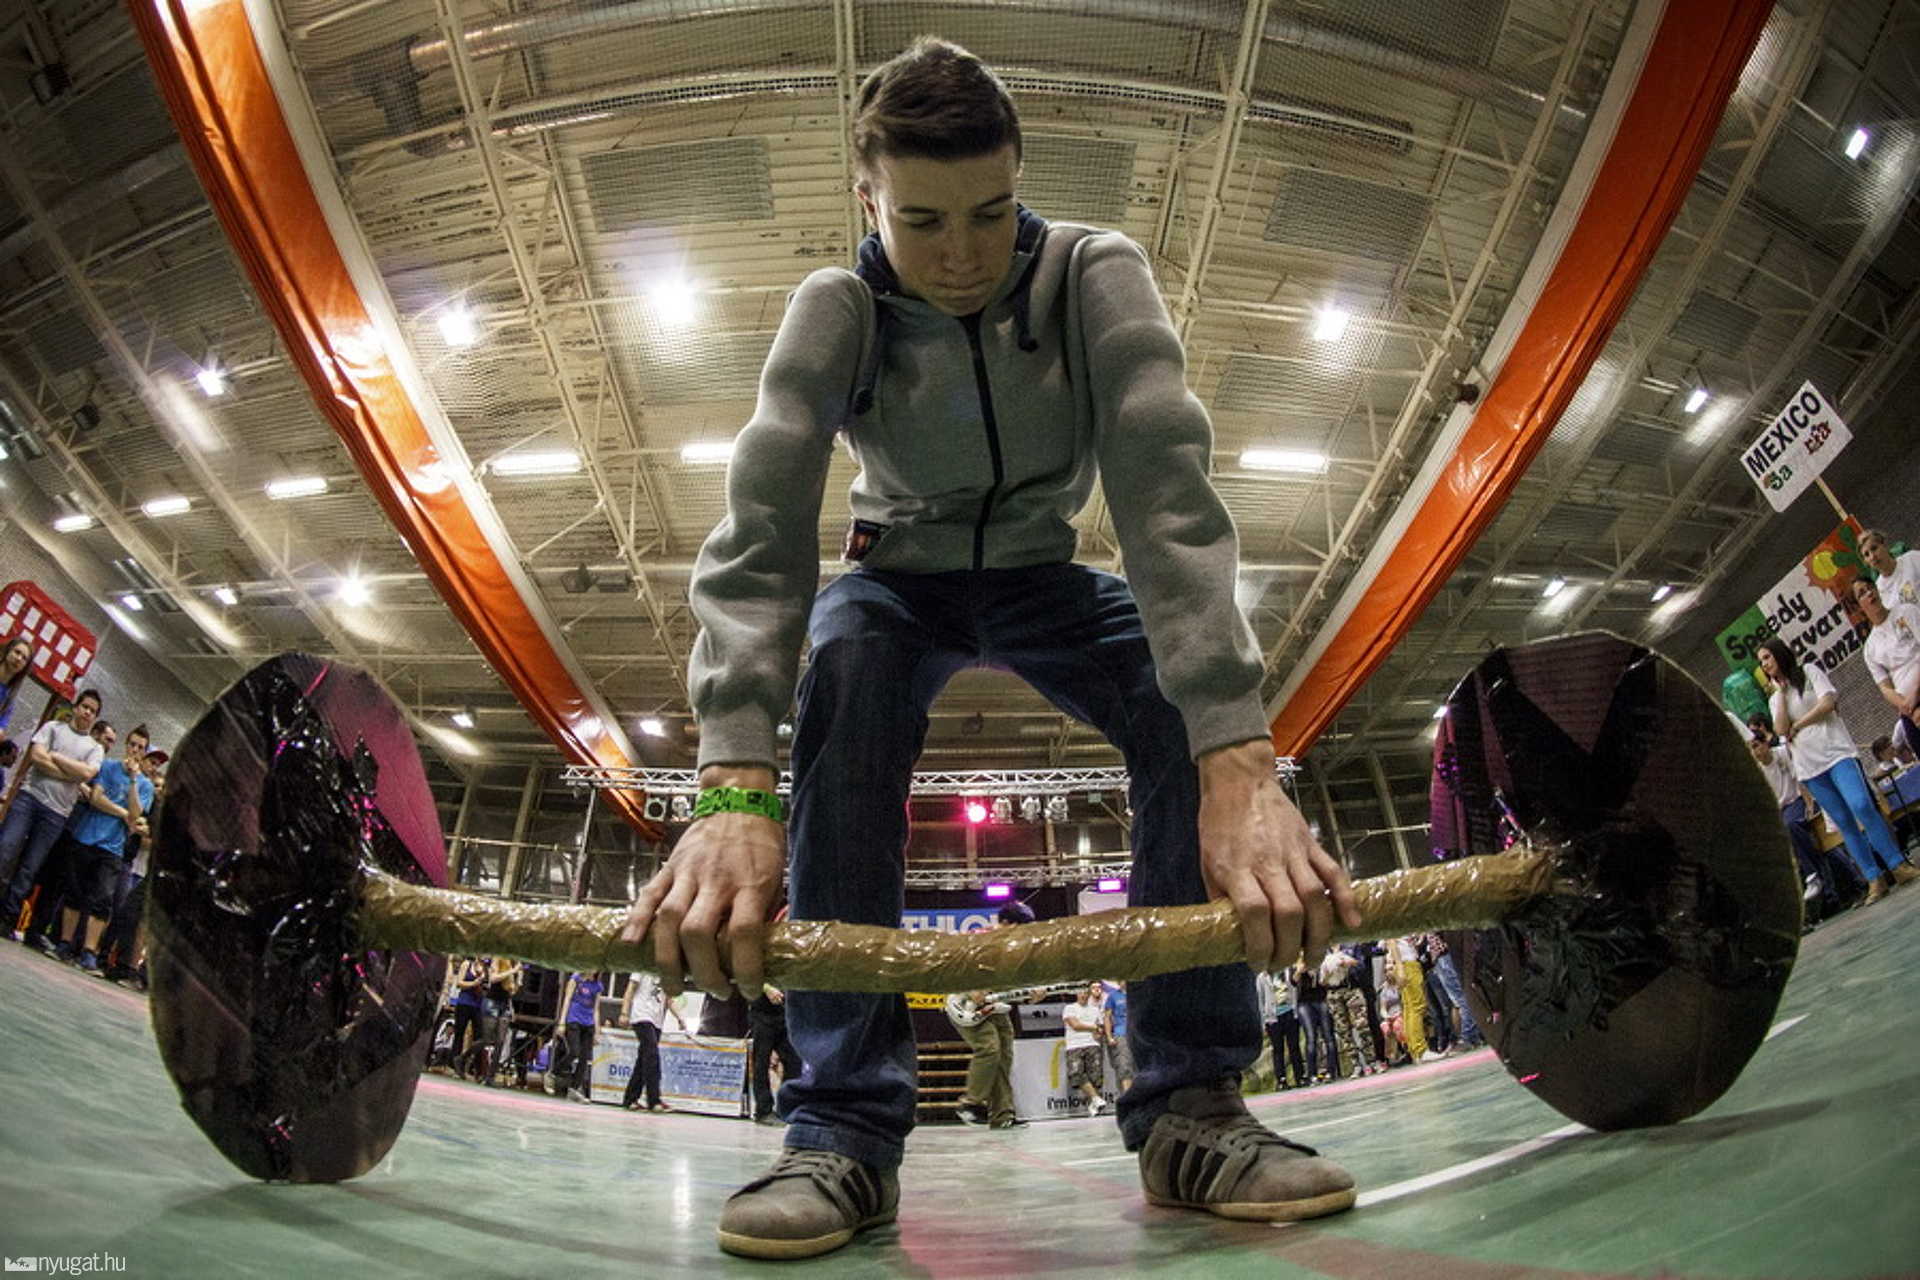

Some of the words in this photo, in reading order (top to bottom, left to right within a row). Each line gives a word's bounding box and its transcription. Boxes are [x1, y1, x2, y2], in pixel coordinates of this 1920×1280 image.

[1745, 391, 1821, 478] MEXICO
[1725, 592, 1812, 660] Speedy
[608, 1063, 632, 1077] DIR
